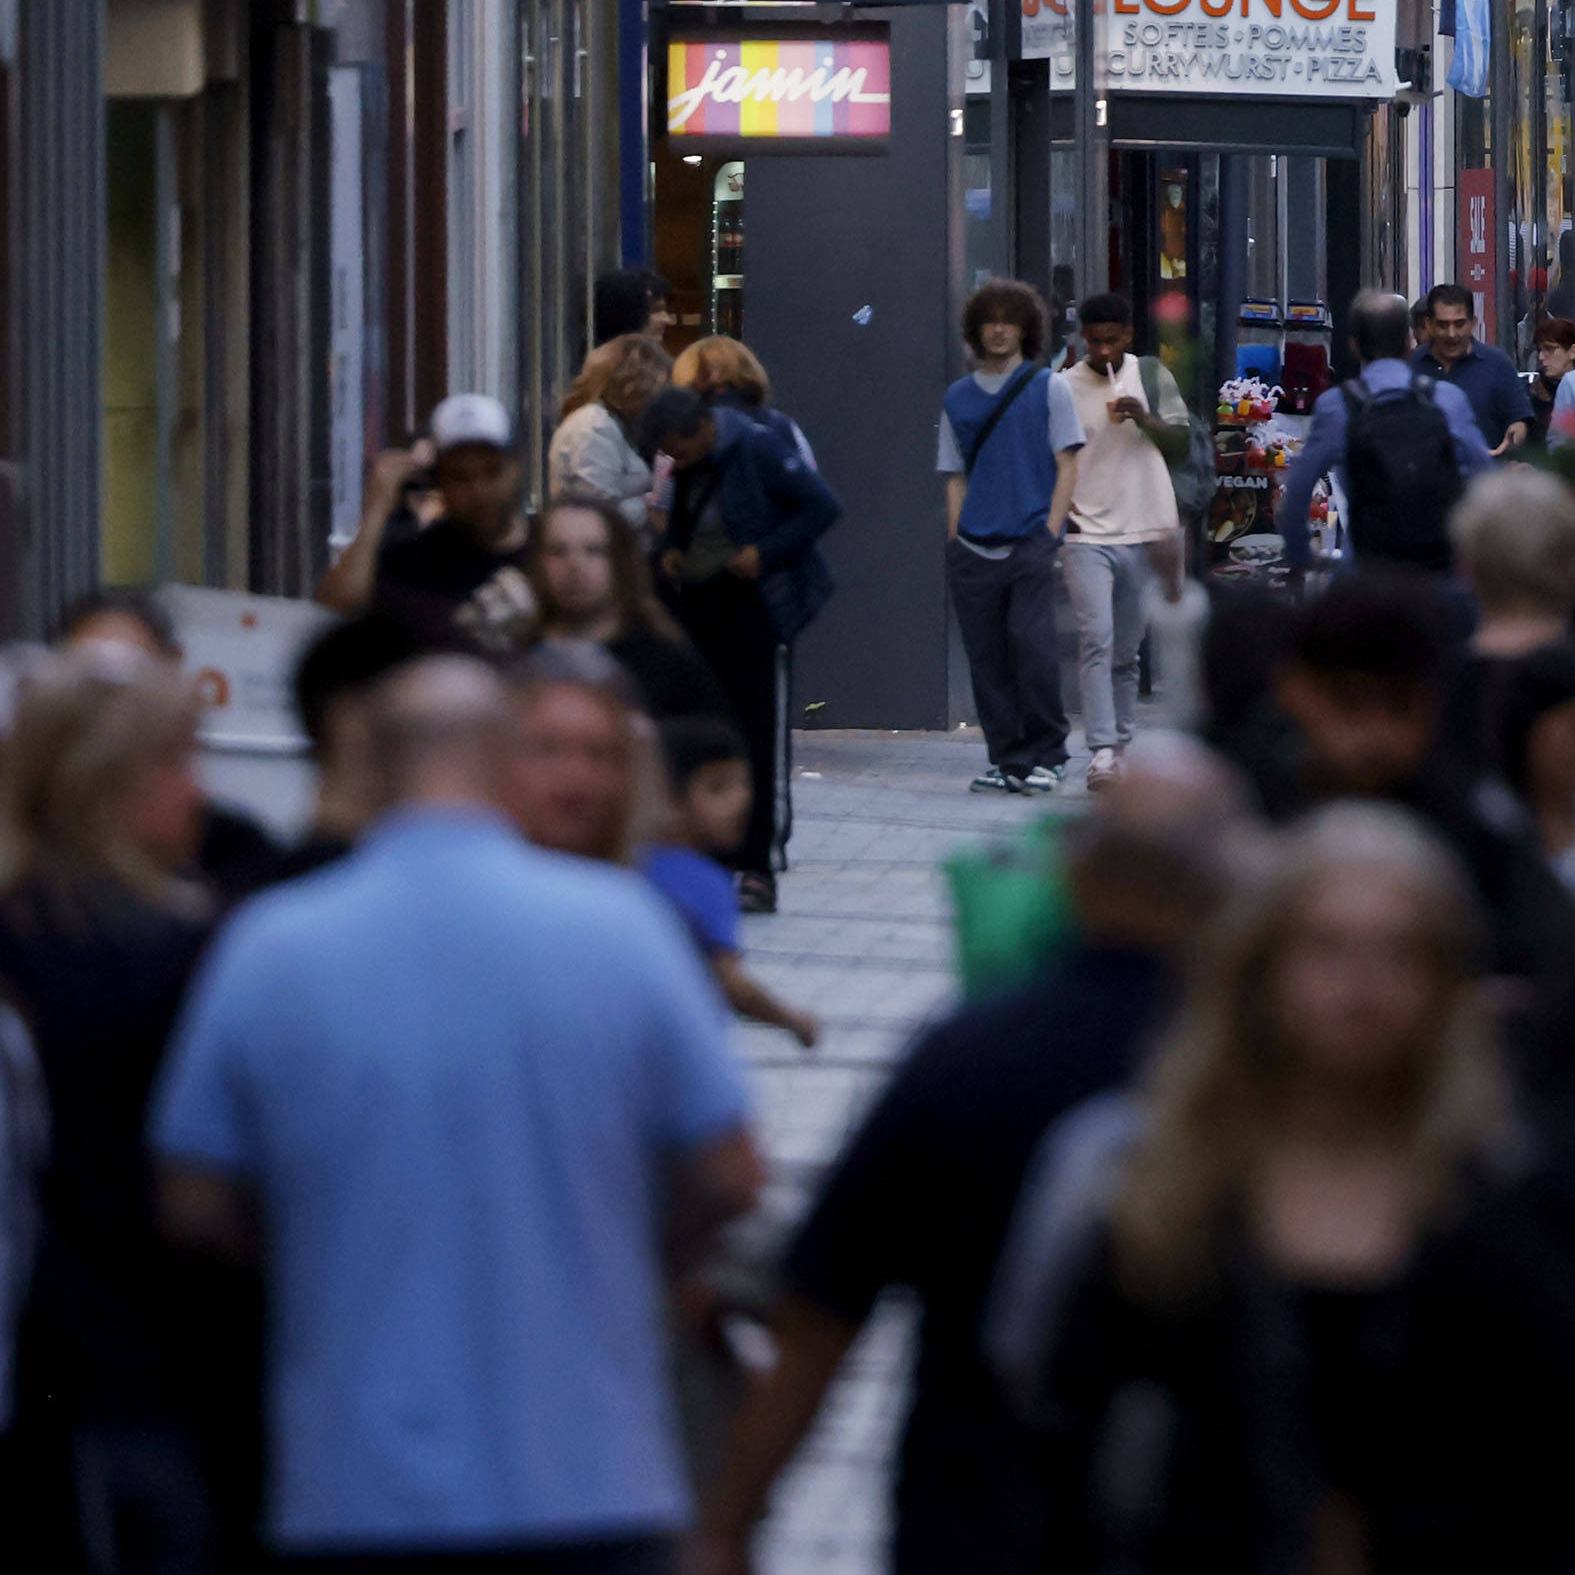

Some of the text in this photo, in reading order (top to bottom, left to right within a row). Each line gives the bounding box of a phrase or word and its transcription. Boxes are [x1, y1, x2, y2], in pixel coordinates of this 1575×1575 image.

[1247, 24, 1368, 53] POMMES
[1106, 51, 1383, 84] CURRYWURST PIZZA
[669, 50, 890, 125] jamin
[1215, 476, 1268, 489] VEGAN
